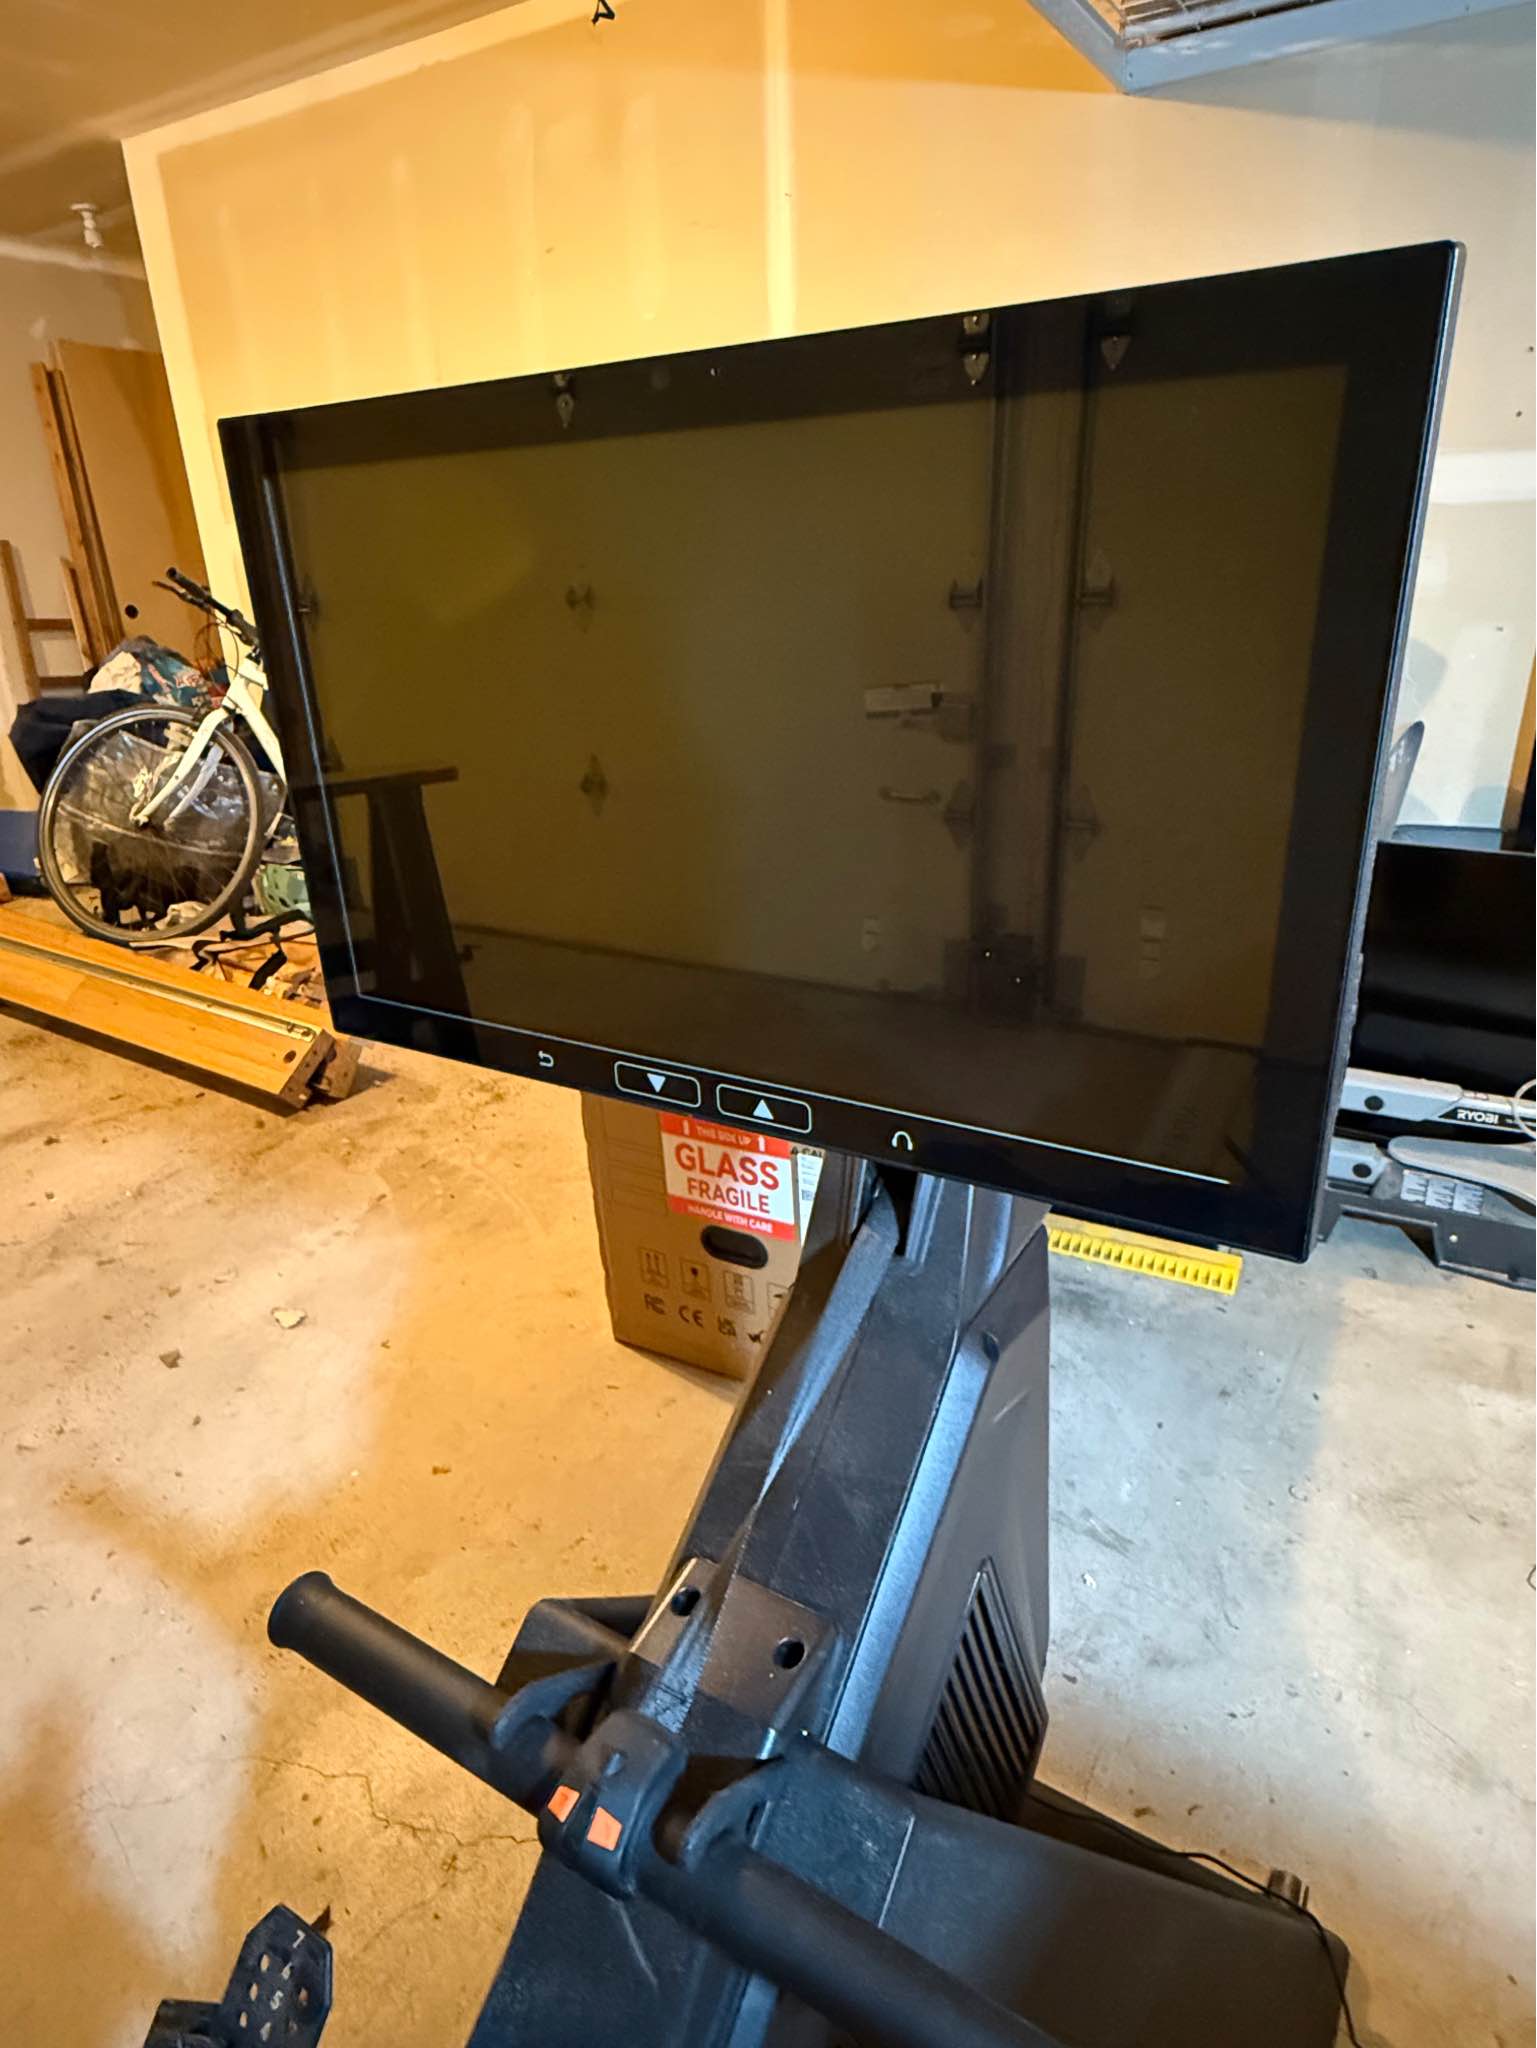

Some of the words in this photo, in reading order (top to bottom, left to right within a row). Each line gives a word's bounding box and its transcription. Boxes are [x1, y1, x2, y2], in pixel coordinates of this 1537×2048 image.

[1456, 1109, 1499, 1125] RYOBI
[696, 1125, 716, 1139] THIS
[738, 1135, 751, 1146] UP
[674, 1142, 780, 1191] GLASS
[687, 1176, 771, 1214] FRAGILE
[687, 1205, 723, 1220] HANDLE
[724, 1213, 748, 1226] WITH
[748, 1218, 773, 1234] CARE
[678, 1305, 704, 1329] CE
[292, 1929, 306, 1948] 7
[270, 1990, 284, 2010] 5
